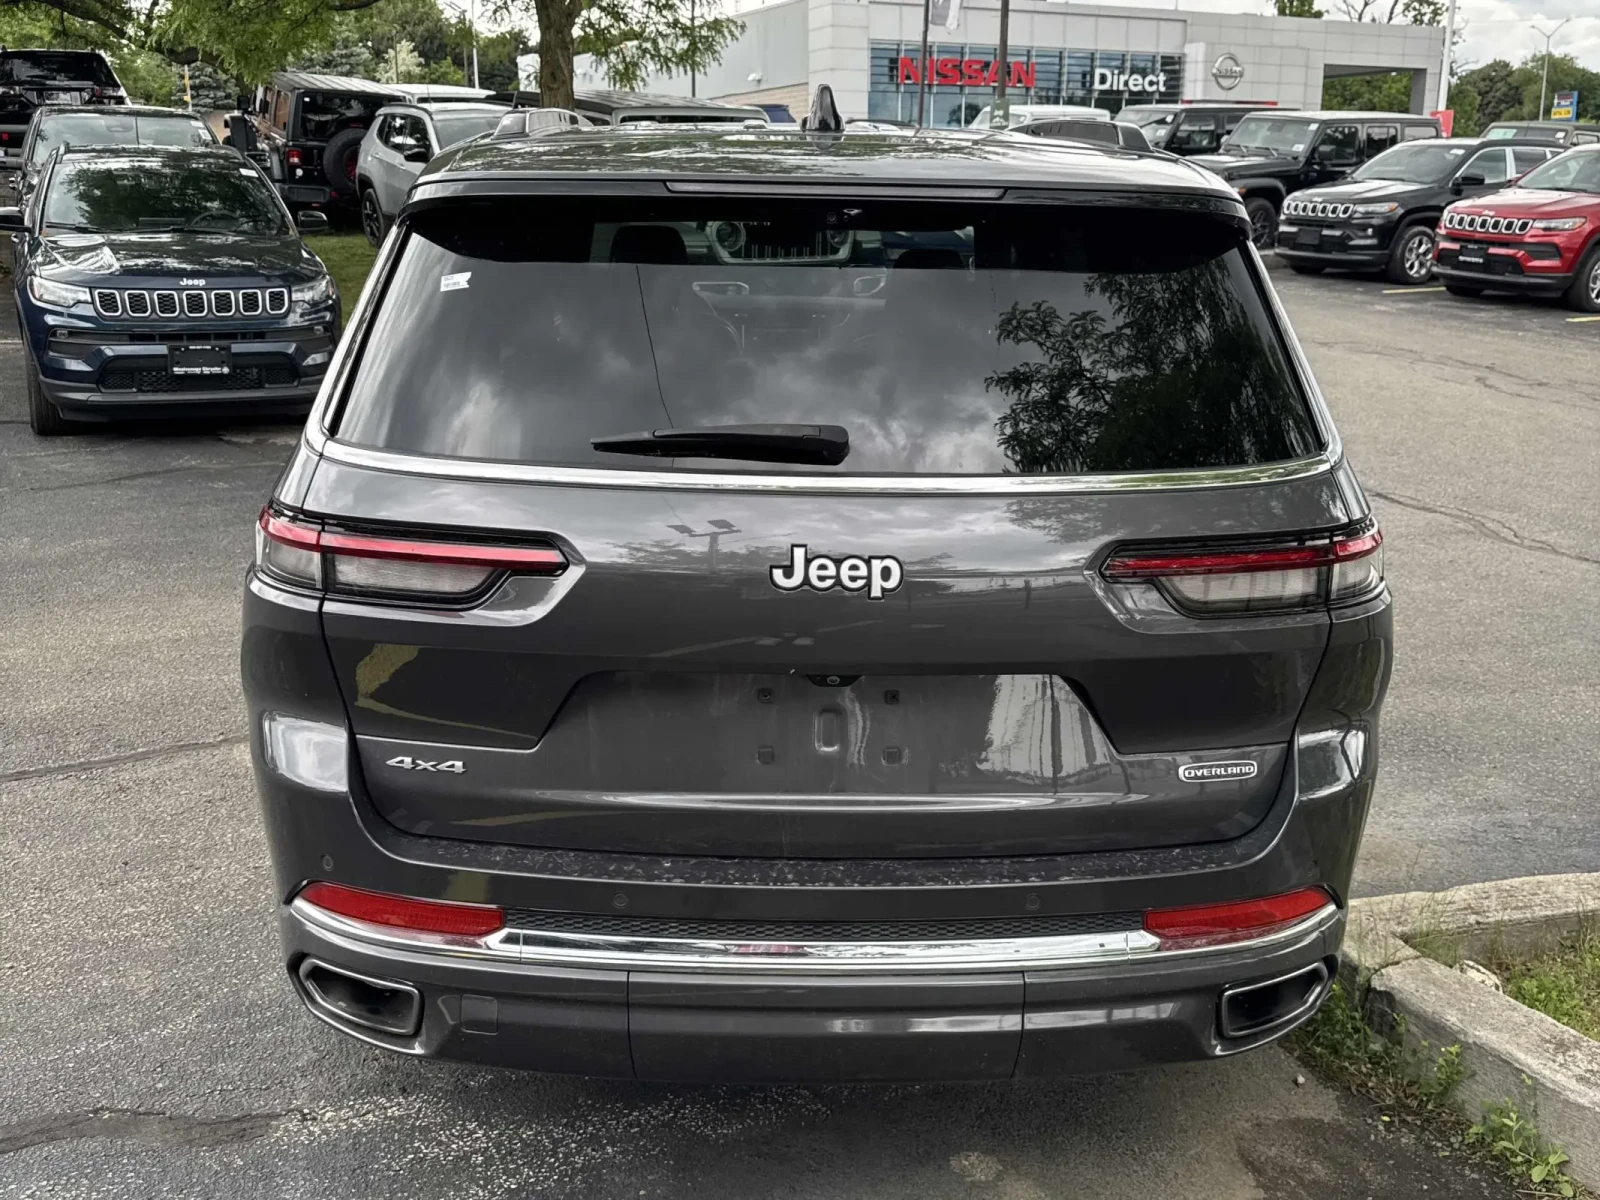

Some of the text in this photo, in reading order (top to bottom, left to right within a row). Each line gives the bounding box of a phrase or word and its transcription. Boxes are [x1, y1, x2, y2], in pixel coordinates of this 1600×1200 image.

[898, 56, 1036, 87] NISSAN
[1093, 68, 1167, 92] Direct
[179, 277, 206, 287] Jeep
[770, 544, 904, 600] Jeep
[385, 755, 467, 774] 4x4
[1184, 766, 1254, 778] OVERLAND
